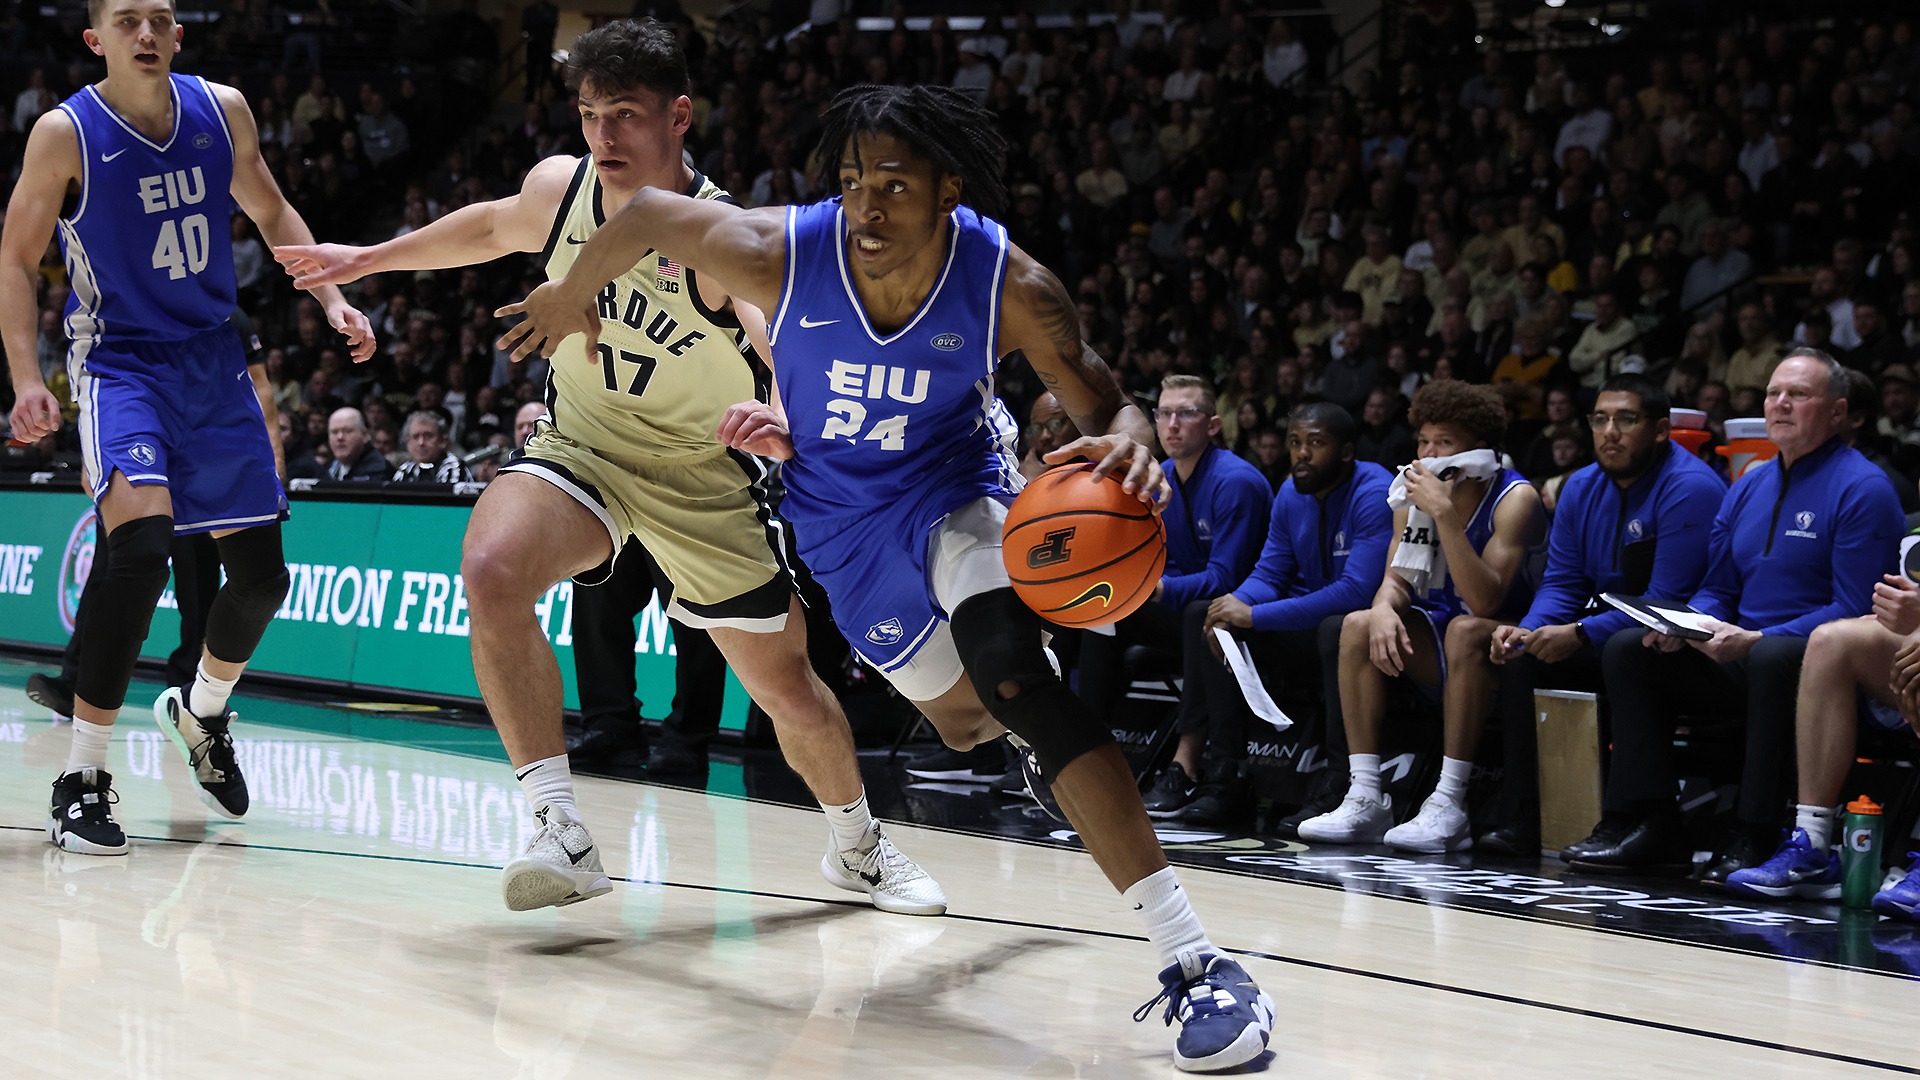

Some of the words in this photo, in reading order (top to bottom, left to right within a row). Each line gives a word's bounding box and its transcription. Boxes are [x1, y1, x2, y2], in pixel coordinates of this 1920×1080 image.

[137, 166, 206, 214] EIU
[152, 213, 210, 280] 40
[596, 280, 707, 357] RDUE
[936, 338, 957, 347] OVC
[597, 342, 658, 397] 17
[825, 359, 931, 404] EIU
[821, 398, 909, 451] 24
[274, 562, 393, 629] INION
[1225, 856, 1606, 914] GLOBAL
[1294, 854, 1837, 926] PURDUE
